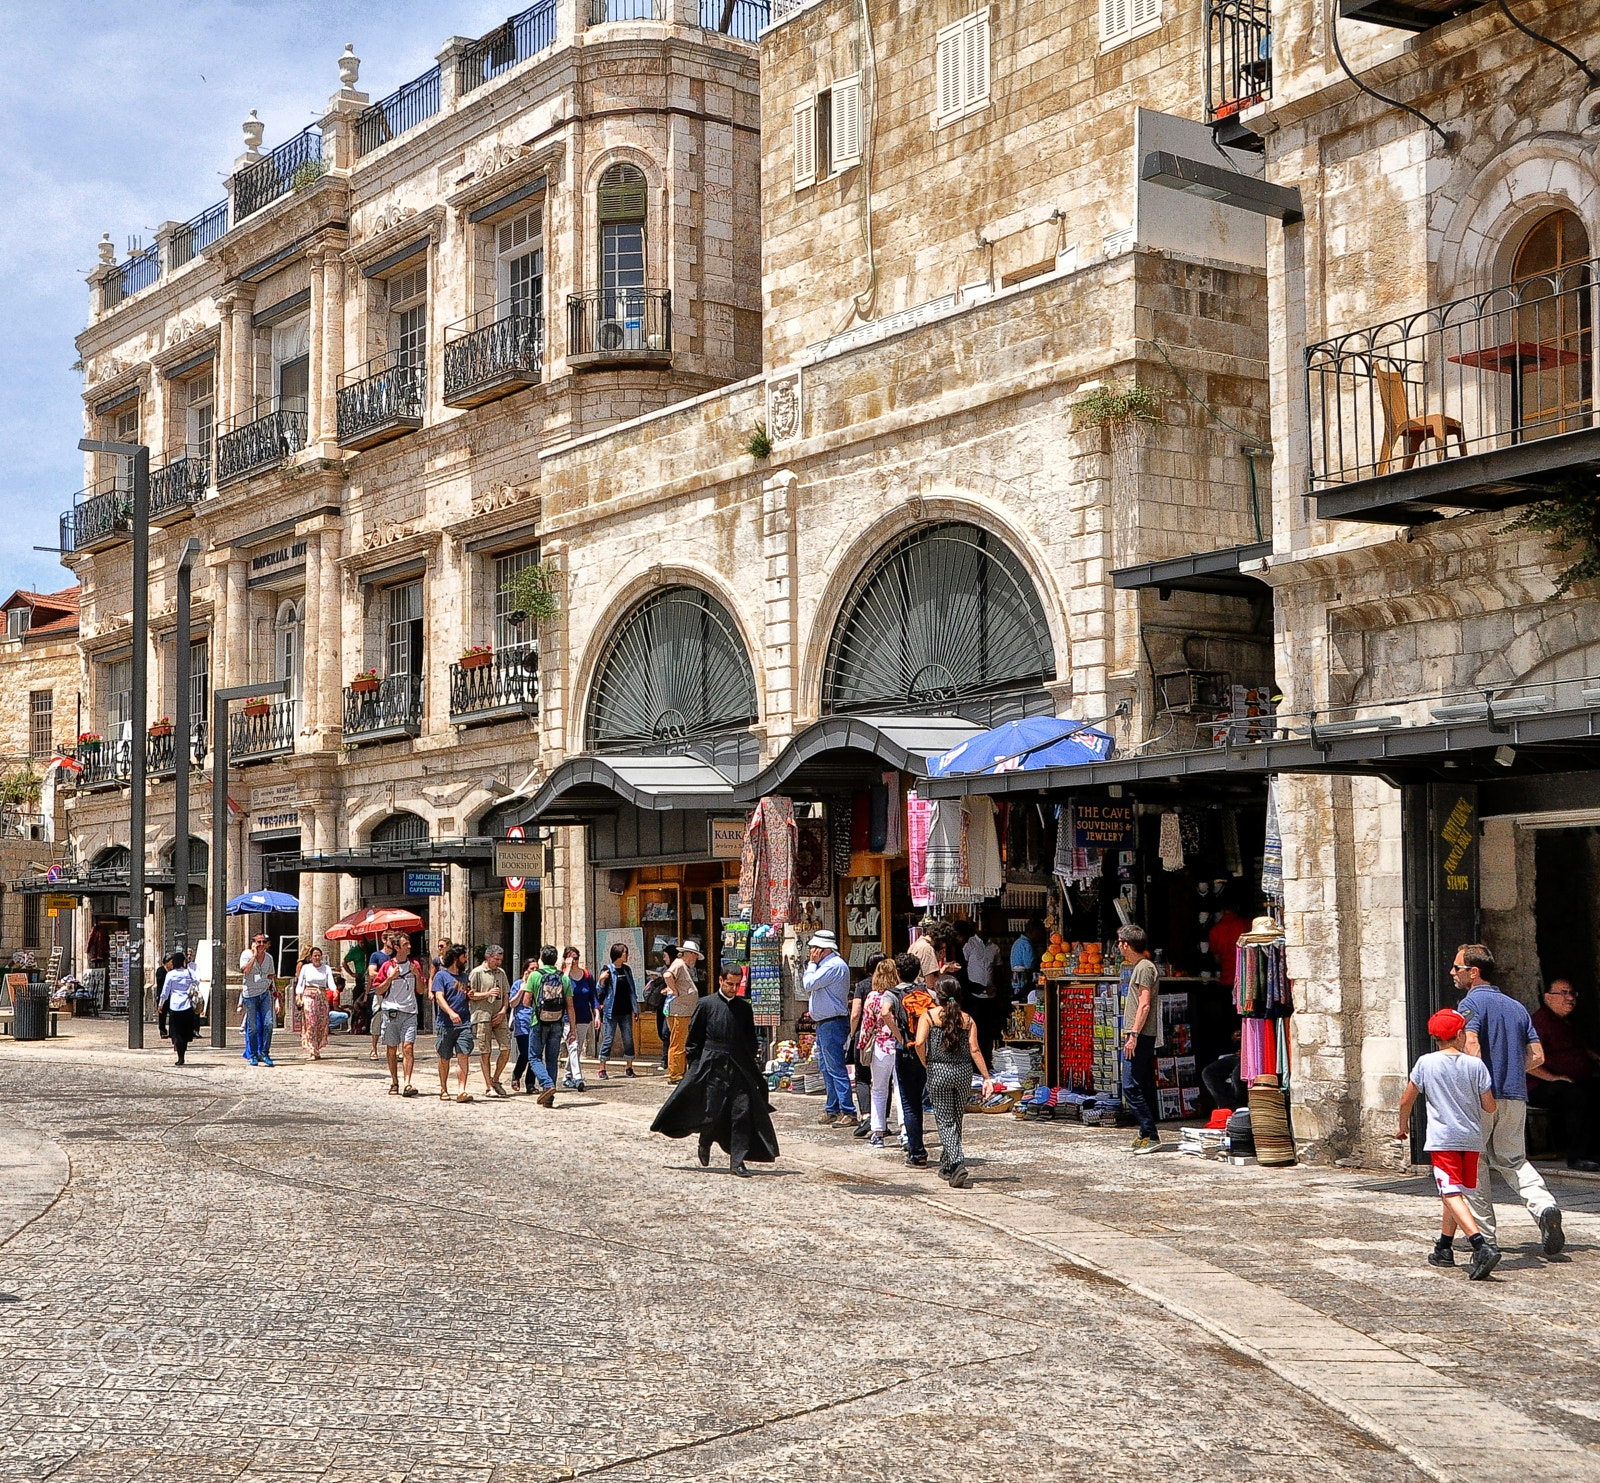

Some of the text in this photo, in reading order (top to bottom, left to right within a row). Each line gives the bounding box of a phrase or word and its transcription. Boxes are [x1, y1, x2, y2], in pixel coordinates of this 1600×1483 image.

[252, 541, 307, 570] IMPERIAL HOT
[1078, 806, 1131, 819] THE CAVE
[1076, 820, 1132, 831] SOUVENIRS &
[1086, 831, 1124, 842] JEWLERY
[498, 852, 541, 860] FRANCISCAN
[501, 862, 539, 870] BOOKSHOP
[1446, 875, 1469, 890] STAMPS
